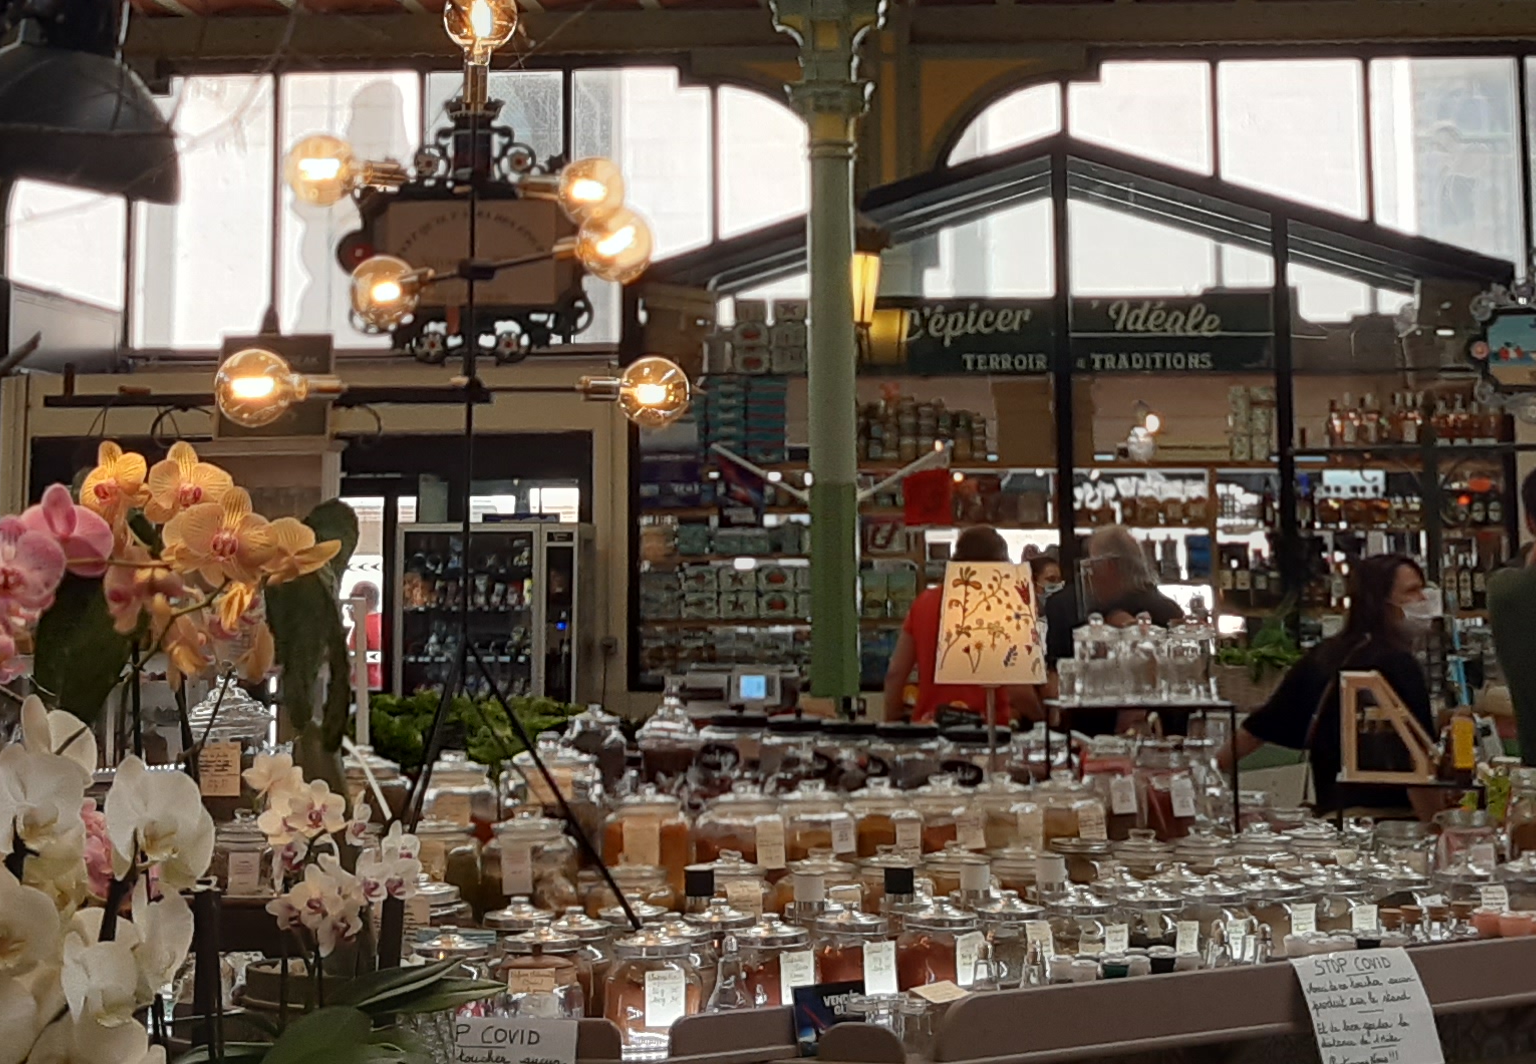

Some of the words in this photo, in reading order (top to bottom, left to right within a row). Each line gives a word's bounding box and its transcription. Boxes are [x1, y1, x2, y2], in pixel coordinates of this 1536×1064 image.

[1108, 299, 1222, 337] Idéale
[962, 352, 1048, 371] TERROIR
[1090, 351, 1214, 371] TRADITIONS
[1314, 956, 1347, 976] STOP
[1353, 955, 1391, 973] COVID
[455, 1023, 472, 1043] P
[481, 1025, 541, 1046] COVID
